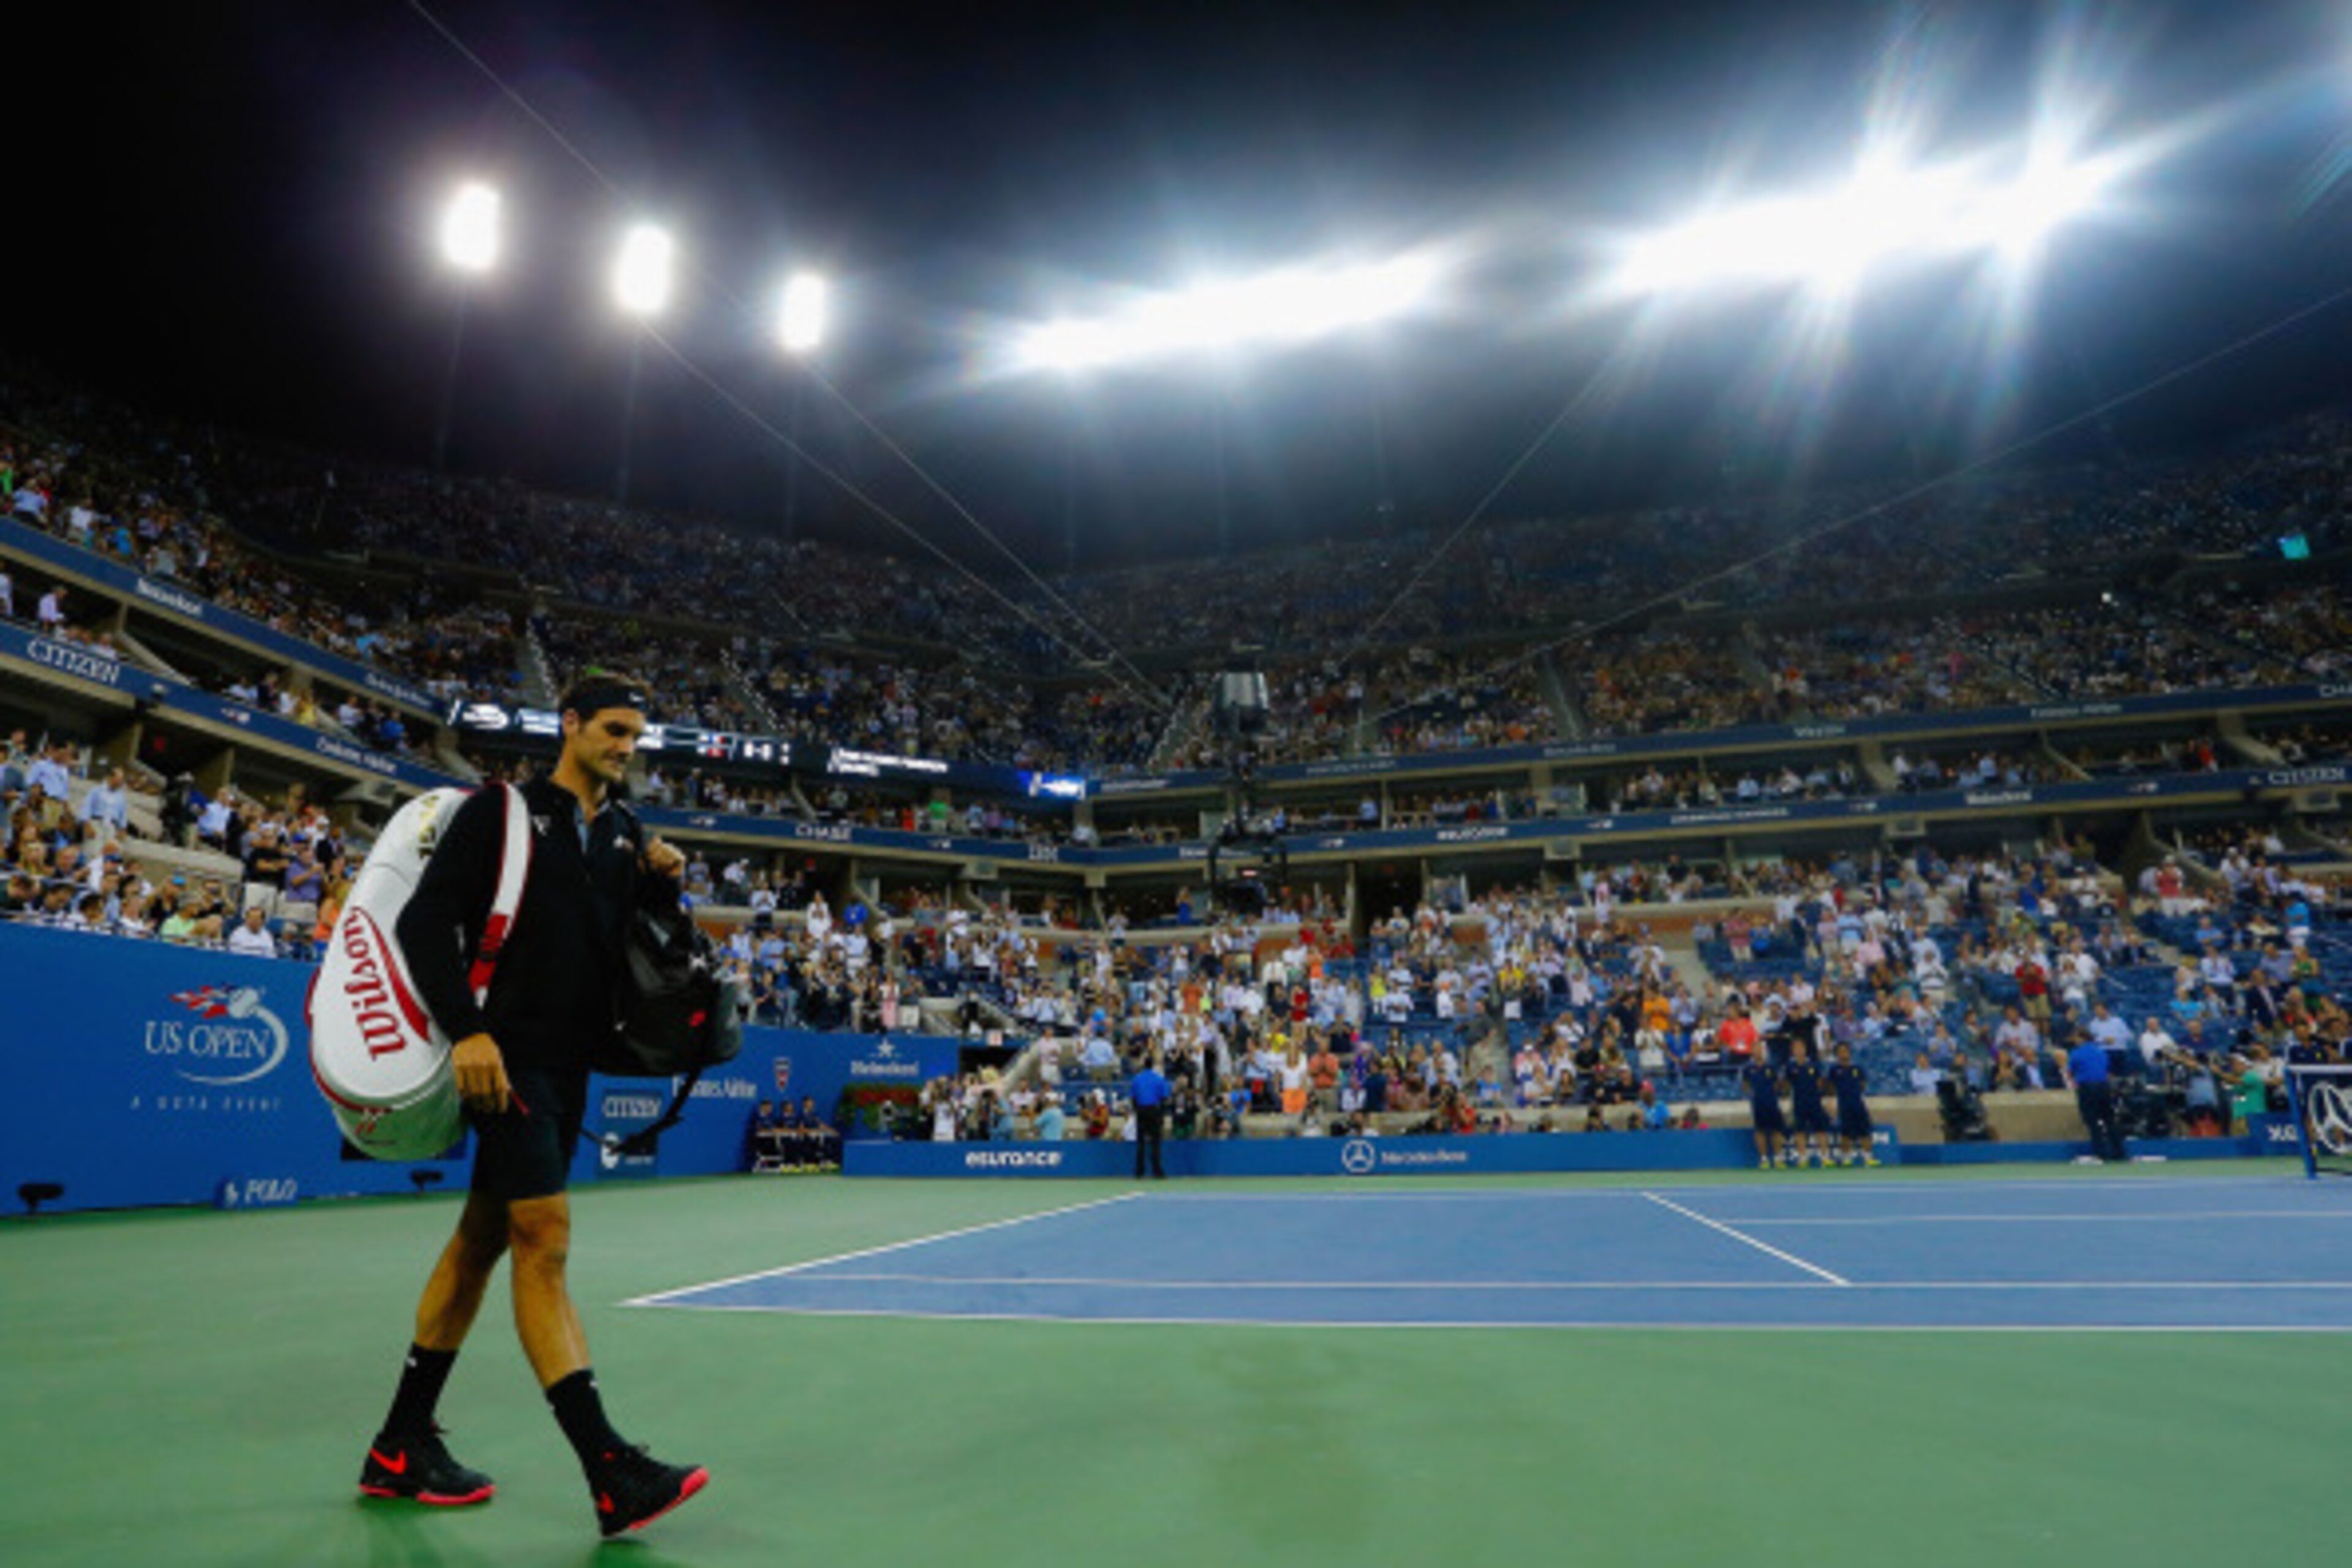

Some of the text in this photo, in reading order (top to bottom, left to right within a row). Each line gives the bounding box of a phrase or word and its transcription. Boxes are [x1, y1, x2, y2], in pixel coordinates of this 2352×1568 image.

[28, 637, 119, 685] CITIZEN
[2268, 767, 2345, 785] CITIZEN
[796, 823, 852, 841] CHASE
[1028, 845, 1058, 862] IBM
[344, 908, 406, 1061] Wilson
[145, 1021, 270, 1058] US OPEN
[851, 1060, 919, 1076] Heineken
[603, 1096, 661, 1117] CITIZEN
[966, 1151, 1063, 1167] esurance
[245, 1178, 298, 1202] POLO
